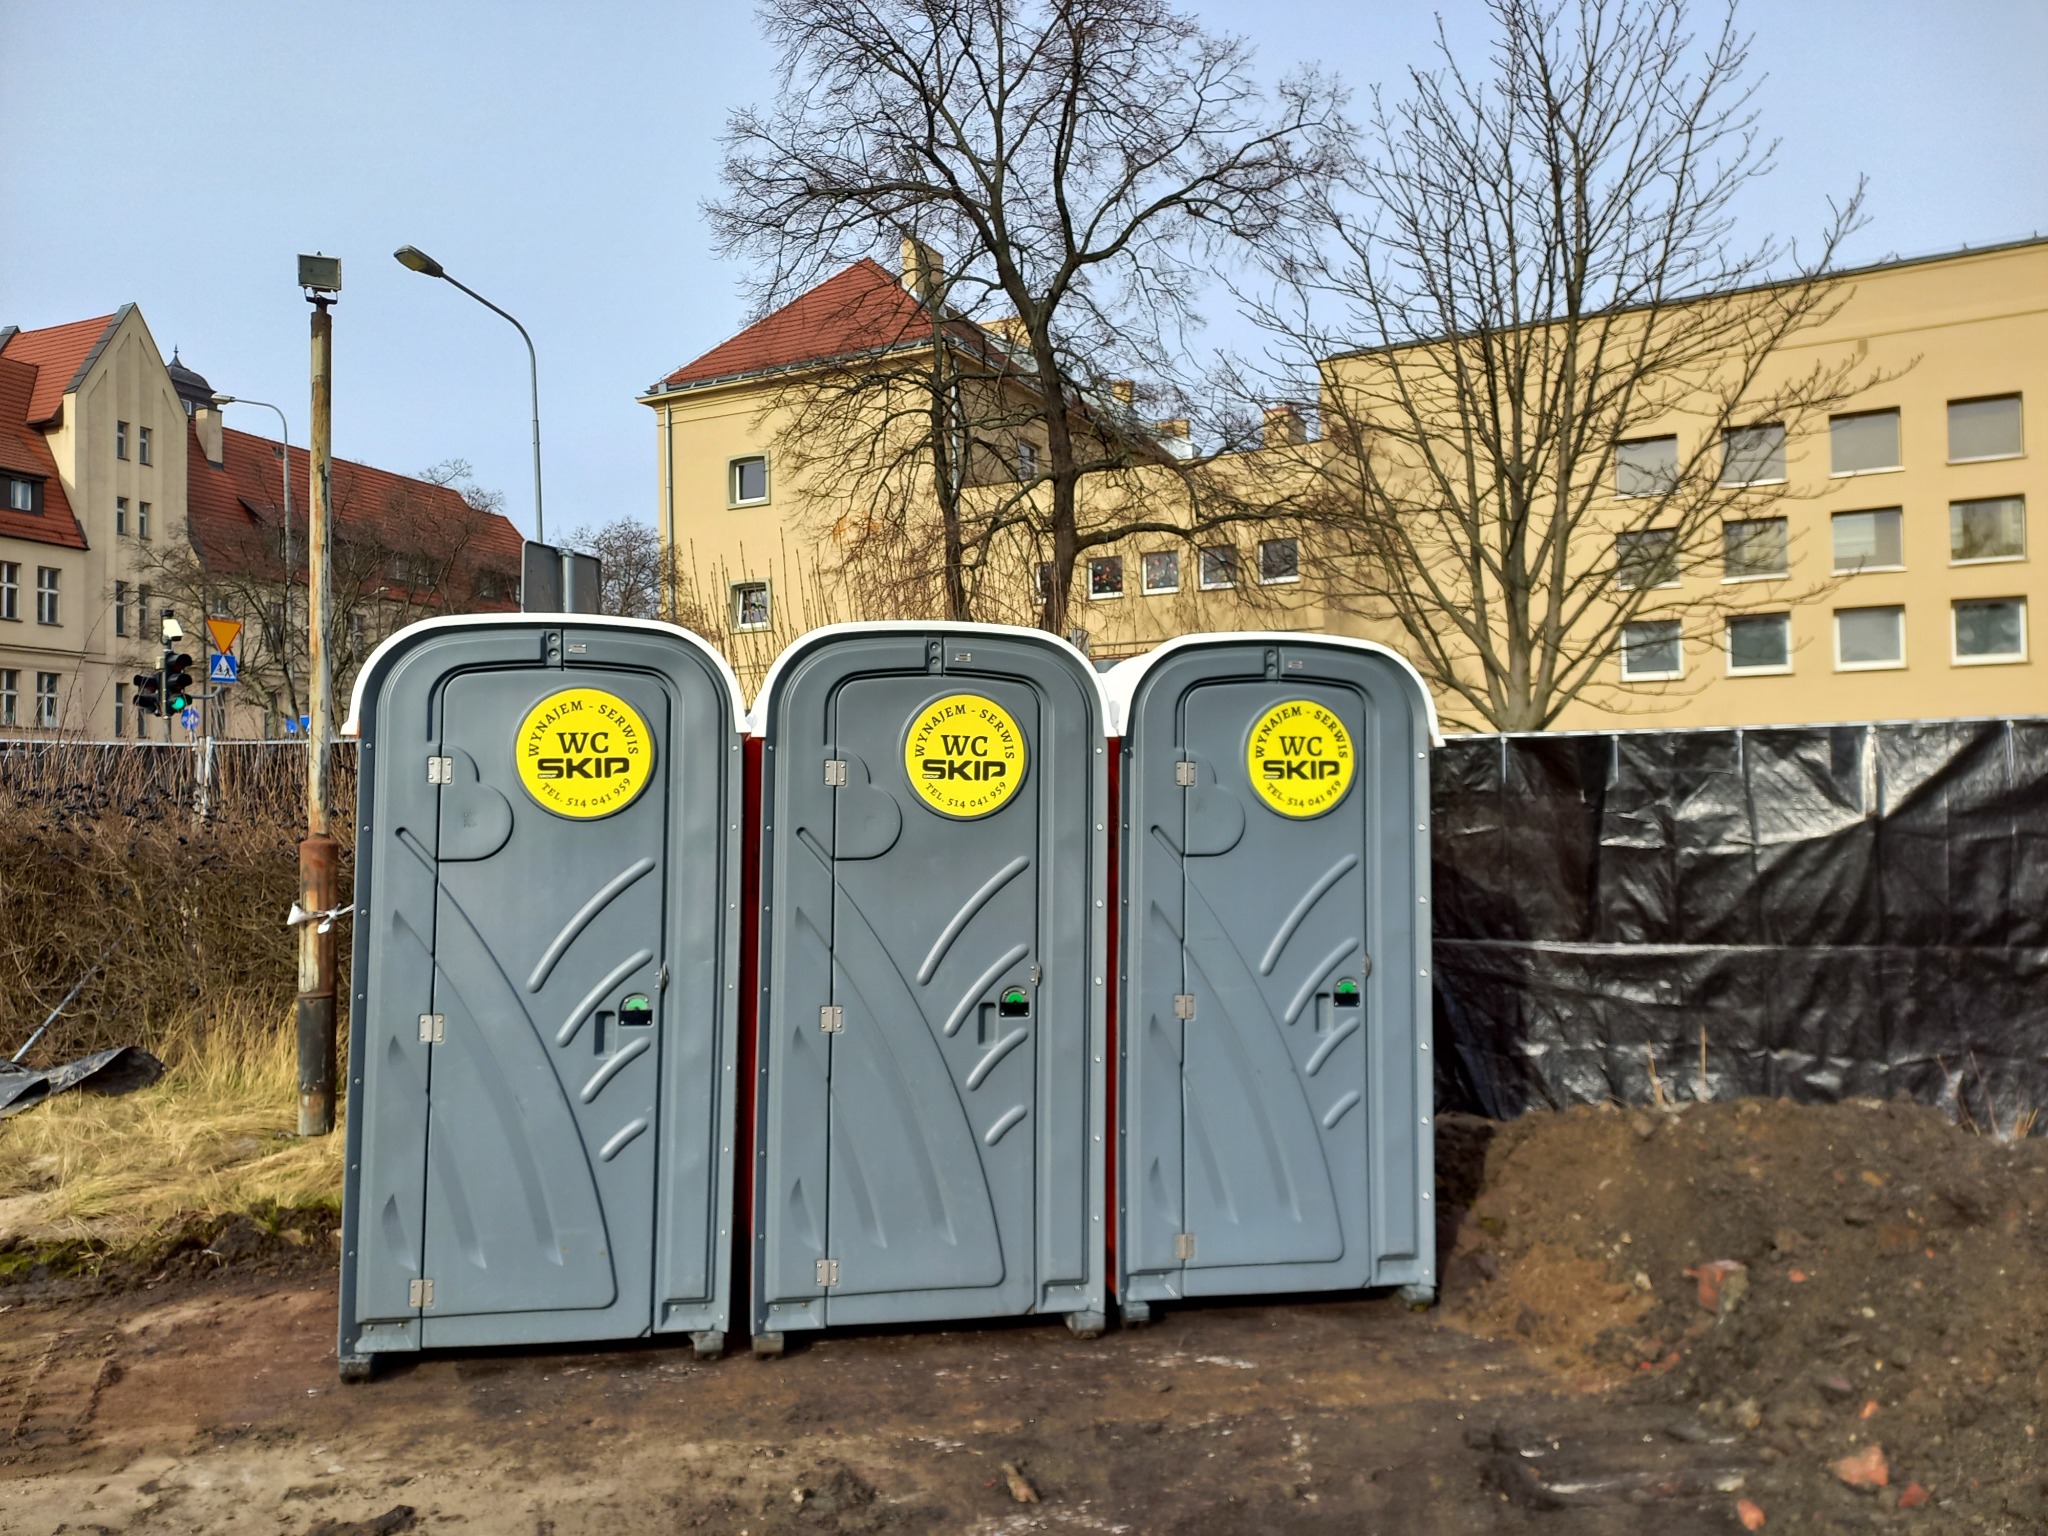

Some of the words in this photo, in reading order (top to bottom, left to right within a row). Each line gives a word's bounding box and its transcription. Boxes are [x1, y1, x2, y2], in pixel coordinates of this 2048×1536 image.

[528, 700, 584, 757] WYNAJEM
[598, 704, 638, 754] SERWIS
[915, 704, 966, 758] WYNAJEM
[979, 709, 1014, 759] SERWIS
[1256, 706, 1302, 758] WYNAJEM
[1314, 711, 1348, 758] SERWIS
[556, 732, 609, 754] WC
[940, 735, 988, 756] WC
[1279, 736, 1322, 756] WC
[537, 757, 629, 779] SKIP
[922, 759, 1006, 781] SKIP
[1263, 760, 1340, 780] SKIP
[542, 783, 562, 802] TEL.
[566, 798, 586, 807] 514
[591, 794, 611, 805] 041
[614, 778, 630, 796] 959
[925, 783, 944, 802] TEL.
[947, 799, 966, 808] 514
[970, 796, 988, 807] 041
[990, 782, 1006, 798] 959
[1266, 783, 1284, 801] TEL.
[1287, 798, 1304, 807] 514
[1308, 795, 1325, 806] 041
[1327, 781, 1341, 797] 959
